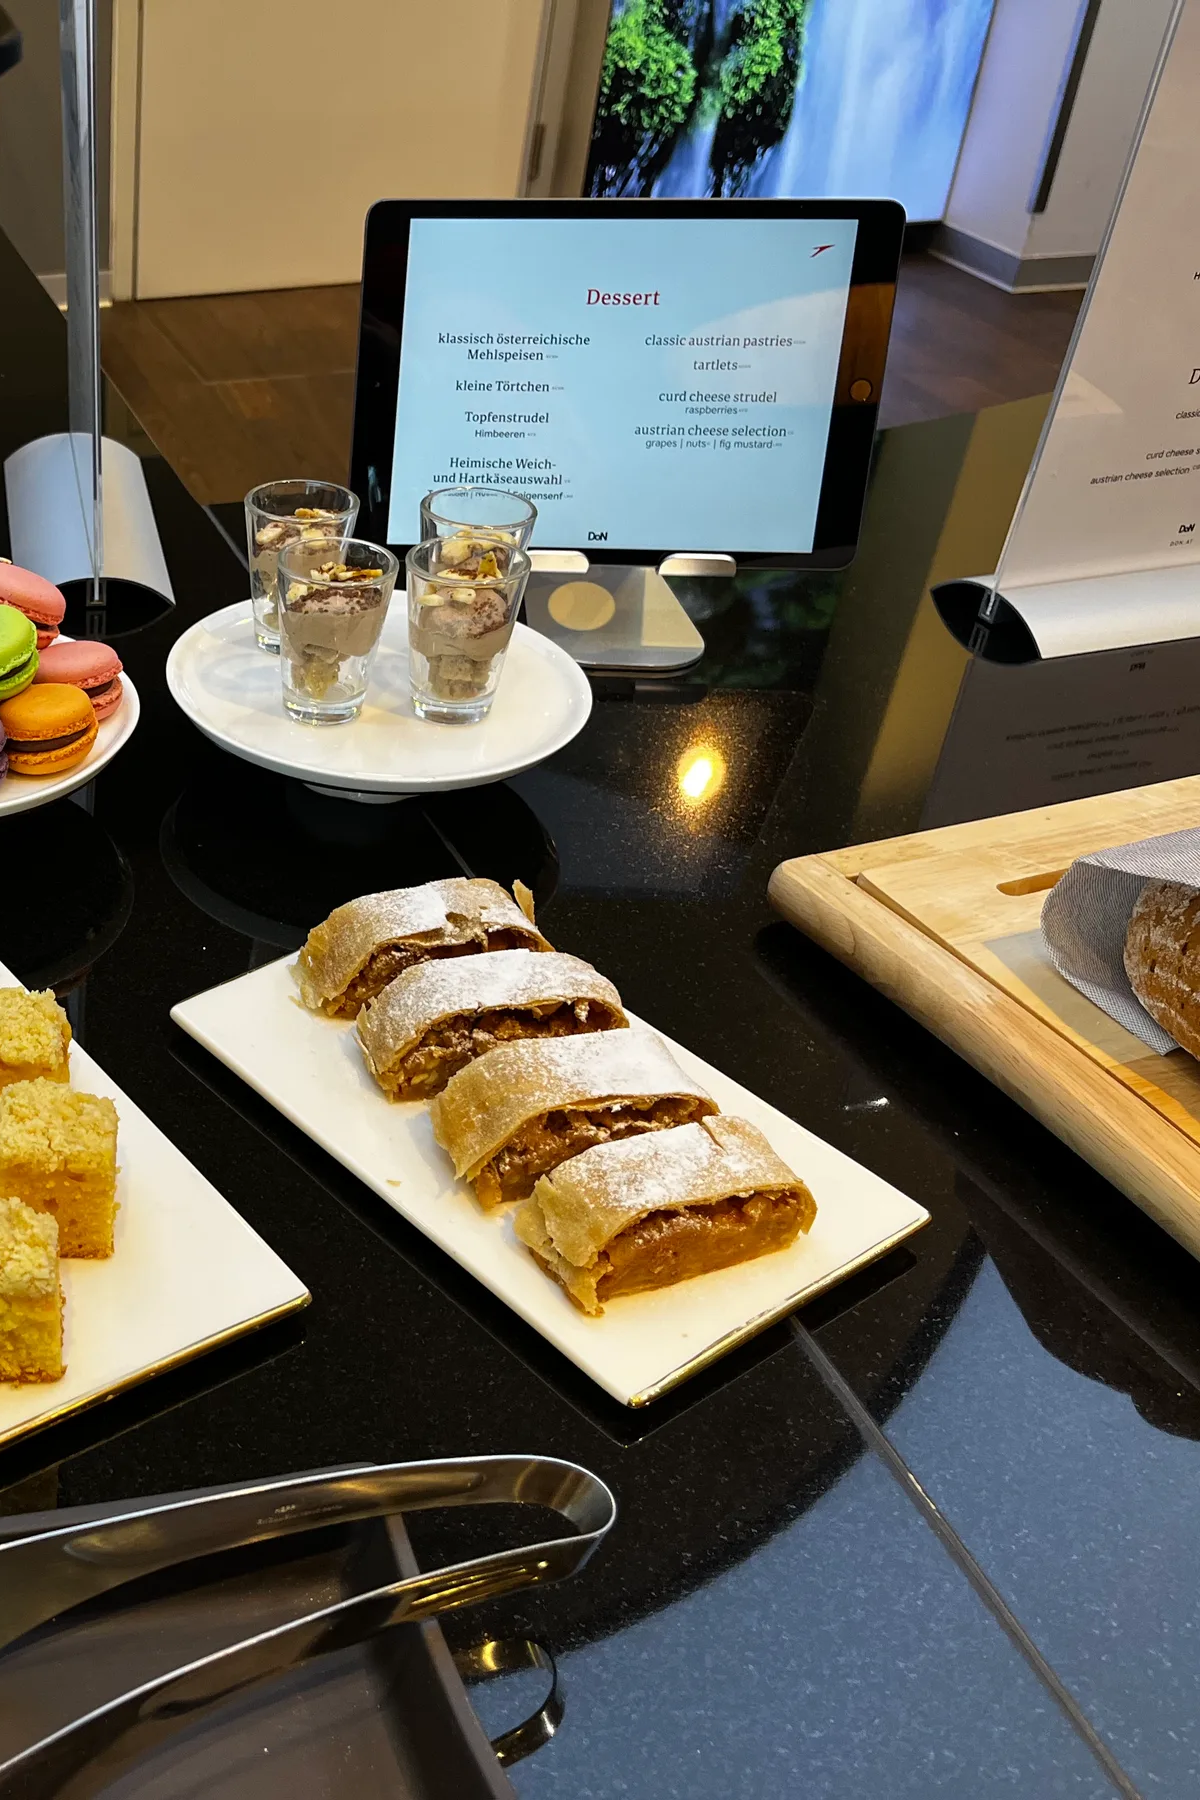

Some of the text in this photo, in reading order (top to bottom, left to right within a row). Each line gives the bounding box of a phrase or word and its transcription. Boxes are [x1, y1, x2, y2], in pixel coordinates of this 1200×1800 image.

[586, 288, 661, 305] Dessert
[438, 332, 591, 345] klassisch österreichische
[645, 334, 686, 346] classic
[688, 334, 740, 346] austrian
[743, 335, 793, 349] pastries
[467, 349, 544, 362] Mehlspeisen
[693, 359, 738, 371] tartlets
[455, 380, 492, 391] kleine
[495, 380, 550, 392] Törtchen
[658, 391, 777, 403] curd cheese strudel
[685, 405, 738, 416] raspberries
[465, 411, 550, 425] Topfenstrudel
[474, 429, 525, 439] Himbeeren
[634, 424, 685, 436] austrian
[687, 424, 729, 436] cheese
[731, 425, 787, 437] selection
[645, 439, 677, 450] grapes
[686, 439, 707, 448] nuts
[719, 439, 731, 450] fig
[733, 440, 772, 449] mustard
[1145, 449, 1165, 460] curd
[1165, 448, 1194, 458] cheese
[449, 457, 557, 469] Heimische Weich-
[433, 473, 456, 483] und
[458, 473, 563, 485] Hartkäseauswahl
[1090, 471, 1123, 485] austrian
[1124, 469, 1153, 482] cheese
[1154, 466, 1190, 478] selection
[588, 531, 608, 541] DoN
